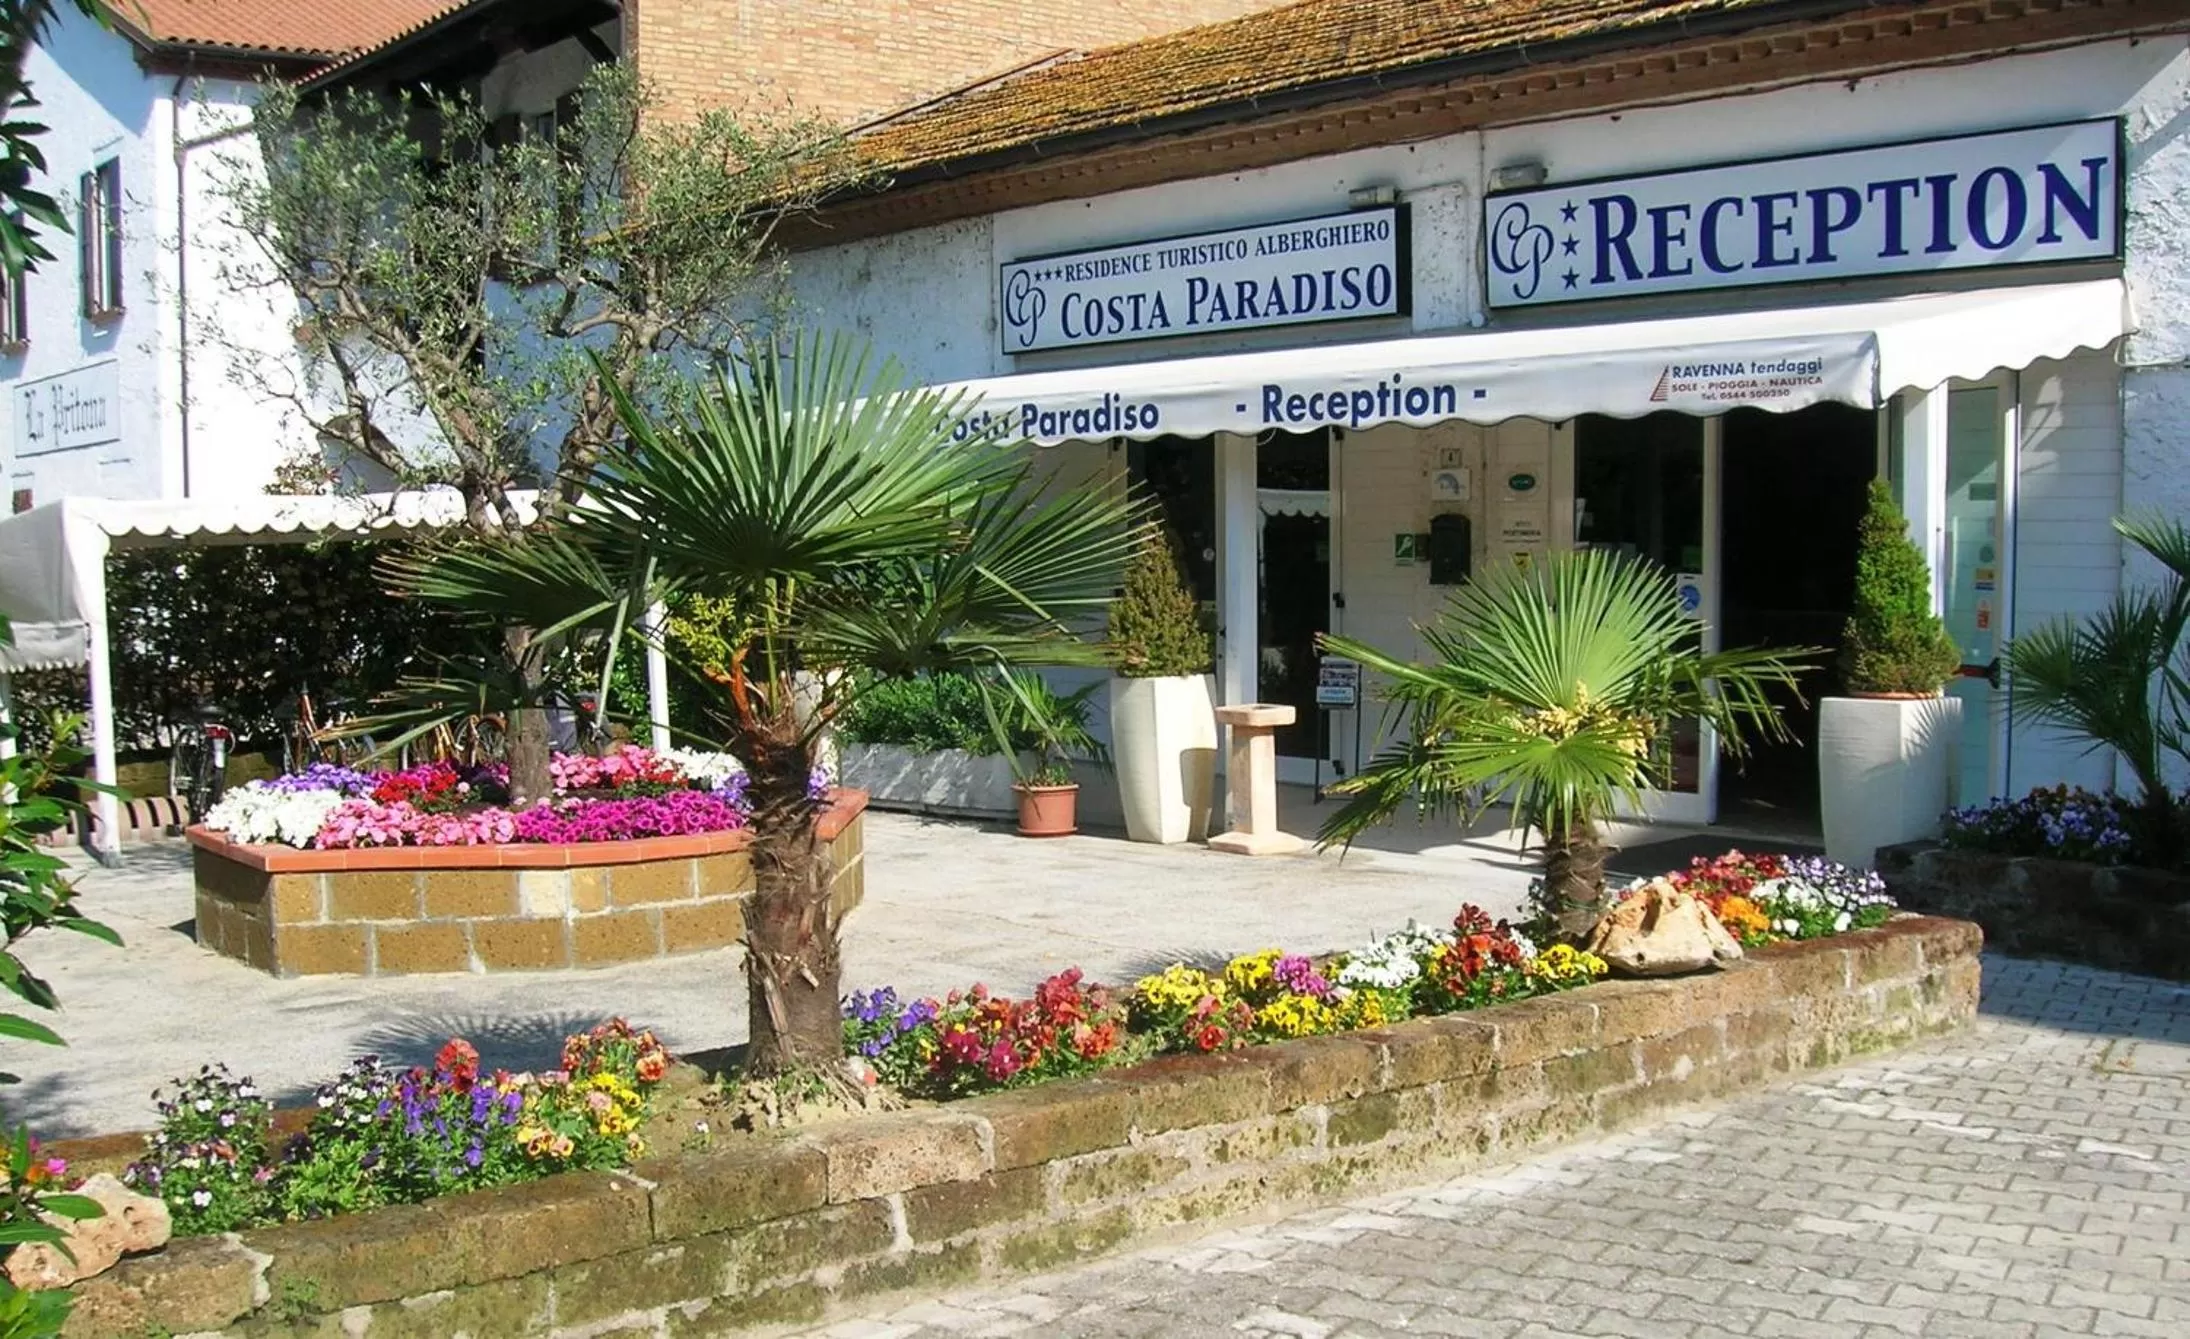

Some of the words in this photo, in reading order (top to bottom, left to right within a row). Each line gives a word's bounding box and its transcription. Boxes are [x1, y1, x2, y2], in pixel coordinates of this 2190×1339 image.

[1065, 257, 1151, 283] RESIDENCE
[1158, 238, 1248, 268] TURISTICO
[1254, 218, 1390, 257] ALBERGHIERO
[1588, 156, 2108, 285] RECEPTION
[1061, 289, 1171, 339] COSTA
[1185, 263, 1392, 326] PARADISO
[1672, 362, 1745, 378] RAVENNA
[1751, 356, 1823, 375] tendaggi
[1672, 383, 1697, 392] SOLE
[1708, 380, 1758, 390] PIOGGIA
[1770, 376, 1823, 386] NAUTICA
[1022, 393, 1159, 437] Paradiso
[1262, 373, 1456, 428] Reception
